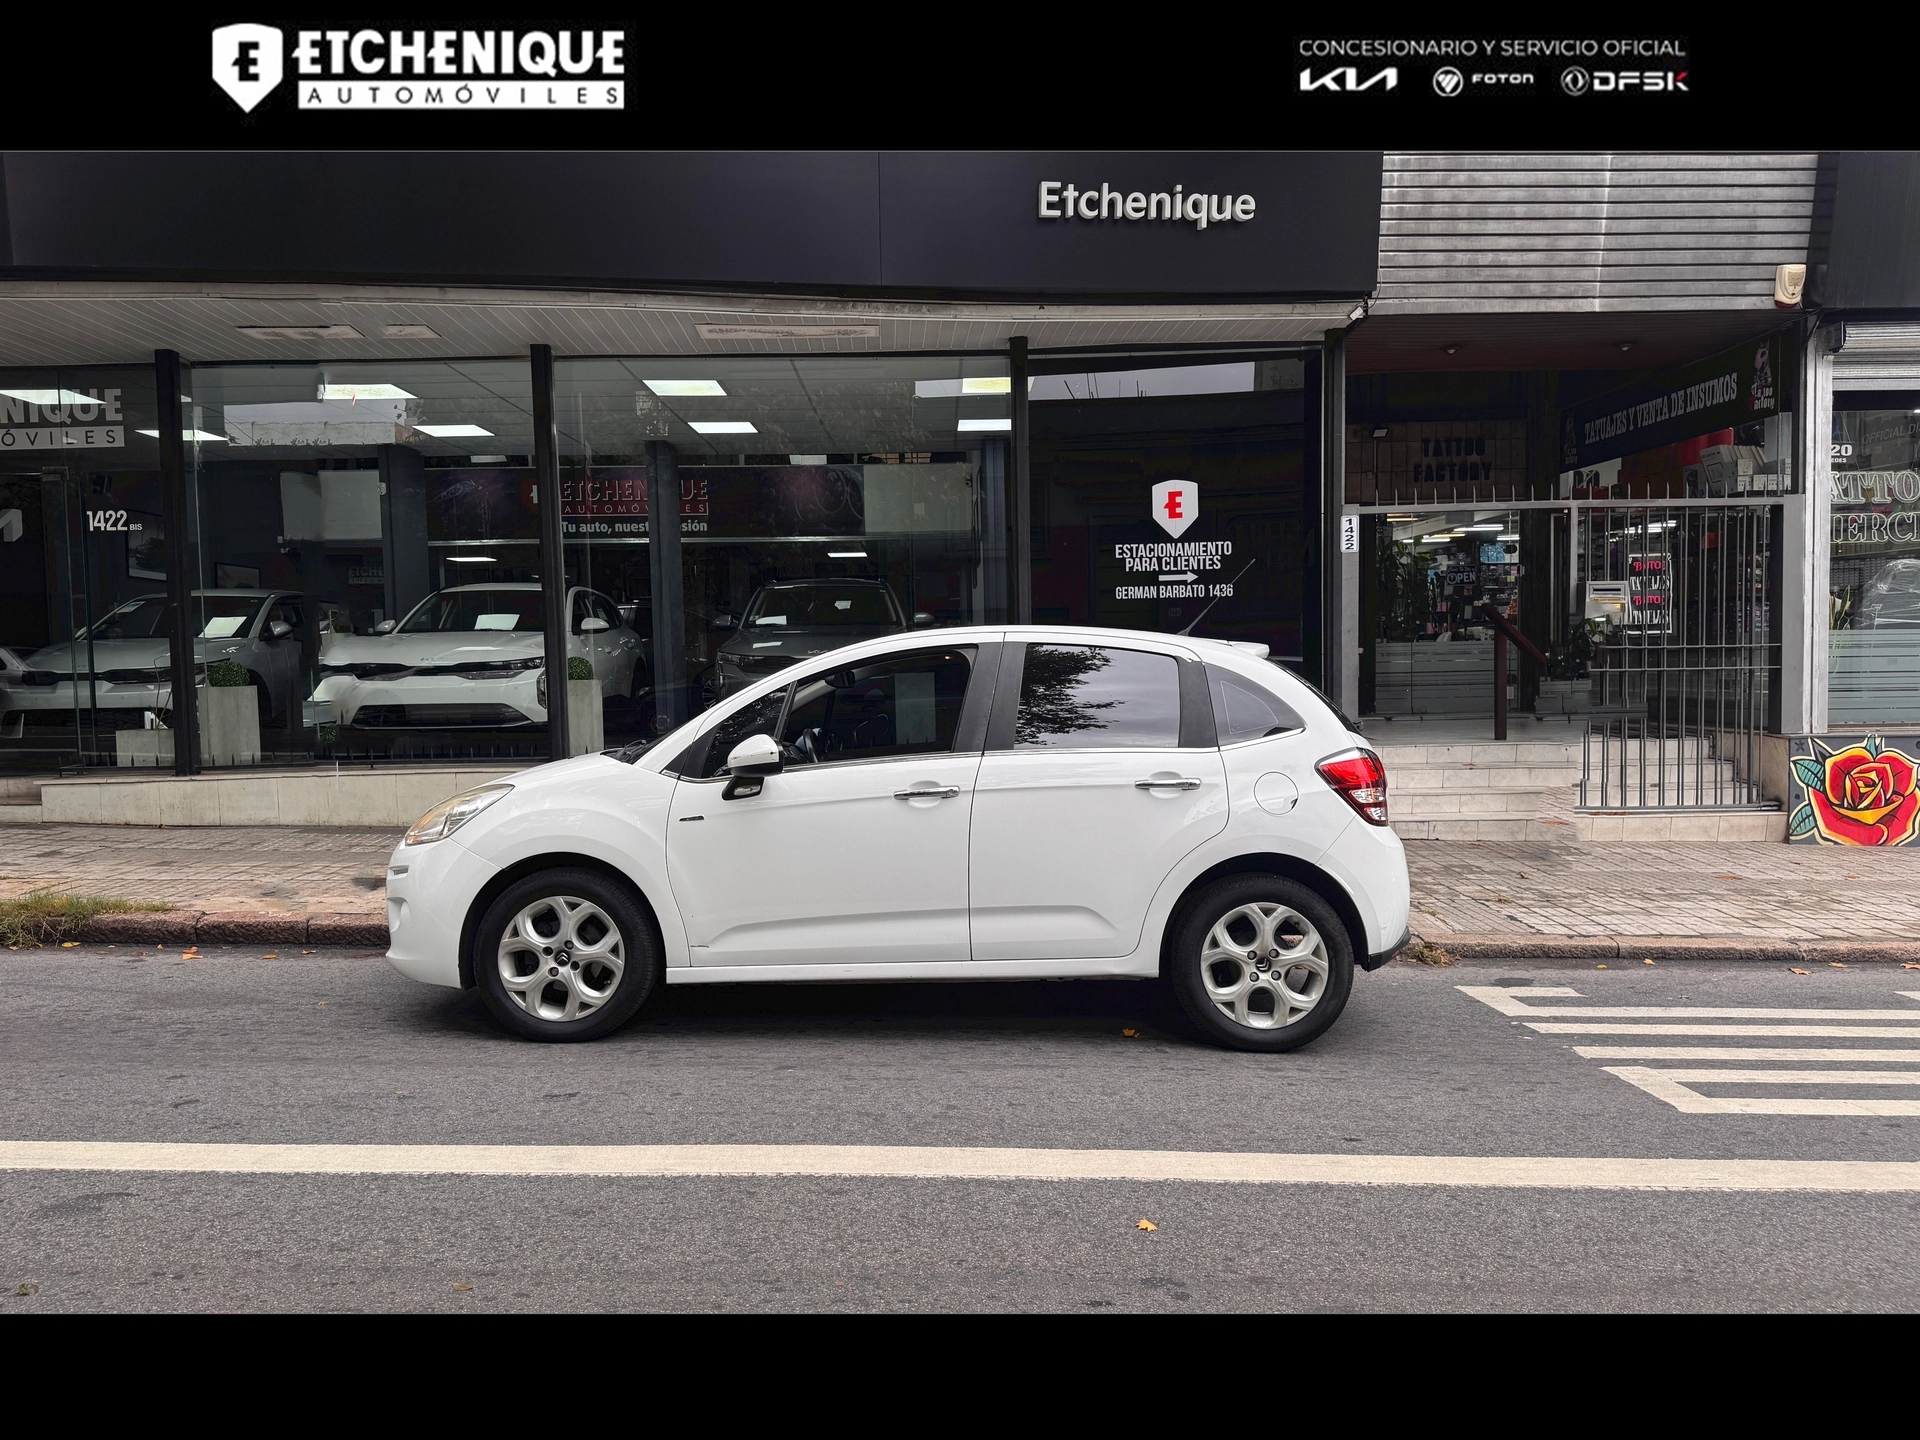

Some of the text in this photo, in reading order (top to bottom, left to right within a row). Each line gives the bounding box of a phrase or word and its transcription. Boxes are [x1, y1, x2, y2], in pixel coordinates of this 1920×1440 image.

[1038, 181, 1256, 230] Etchenique
[1584, 372, 1738, 445] TATUAJES Y VENTA DE INSUMOS
[1861, 425, 1906, 444] OFFICIAL
[1422, 436, 1485, 457] TATTOO
[1413, 461, 1492, 483] FACTORY
[561, 479, 708, 501] ETCHENUE
[564, 503, 705, 513] AUTOMÓES
[86, 509, 143, 531] 1422 BIS
[562, 521, 577, 532] Tu
[579, 521, 613, 535] auto,
[1344, 518, 1355, 550] 1422
[1115, 541, 1232, 559] ESTACIONAMIENTO
[1125, 555, 1222, 572] PARA CLIENTES
[1446, 571, 1476, 584] OPEN
[1115, 584, 1234, 600] GERMAN BARBATO 1436
